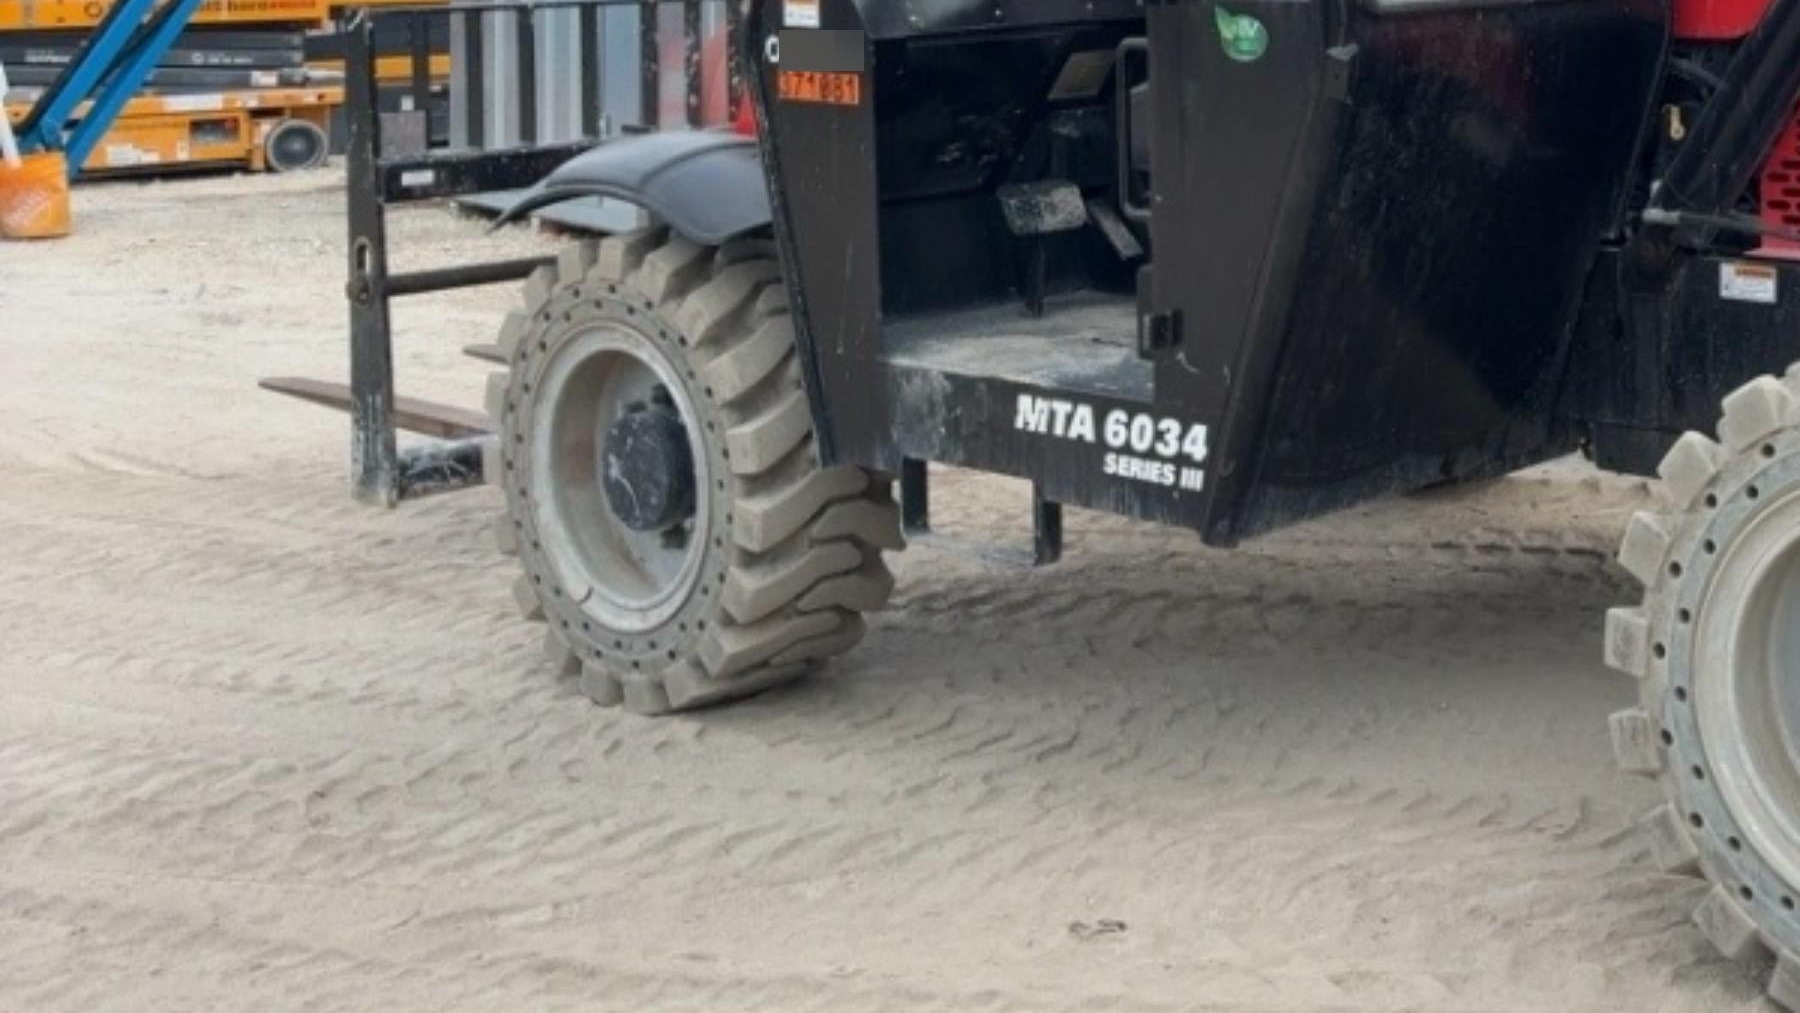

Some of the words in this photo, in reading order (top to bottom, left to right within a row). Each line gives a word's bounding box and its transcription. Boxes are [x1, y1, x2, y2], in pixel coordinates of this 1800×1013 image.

[1014, 393, 1096, 444] MTA
[1103, 408, 1208, 462] 6034
[1103, 452, 1176, 486] SERIES
